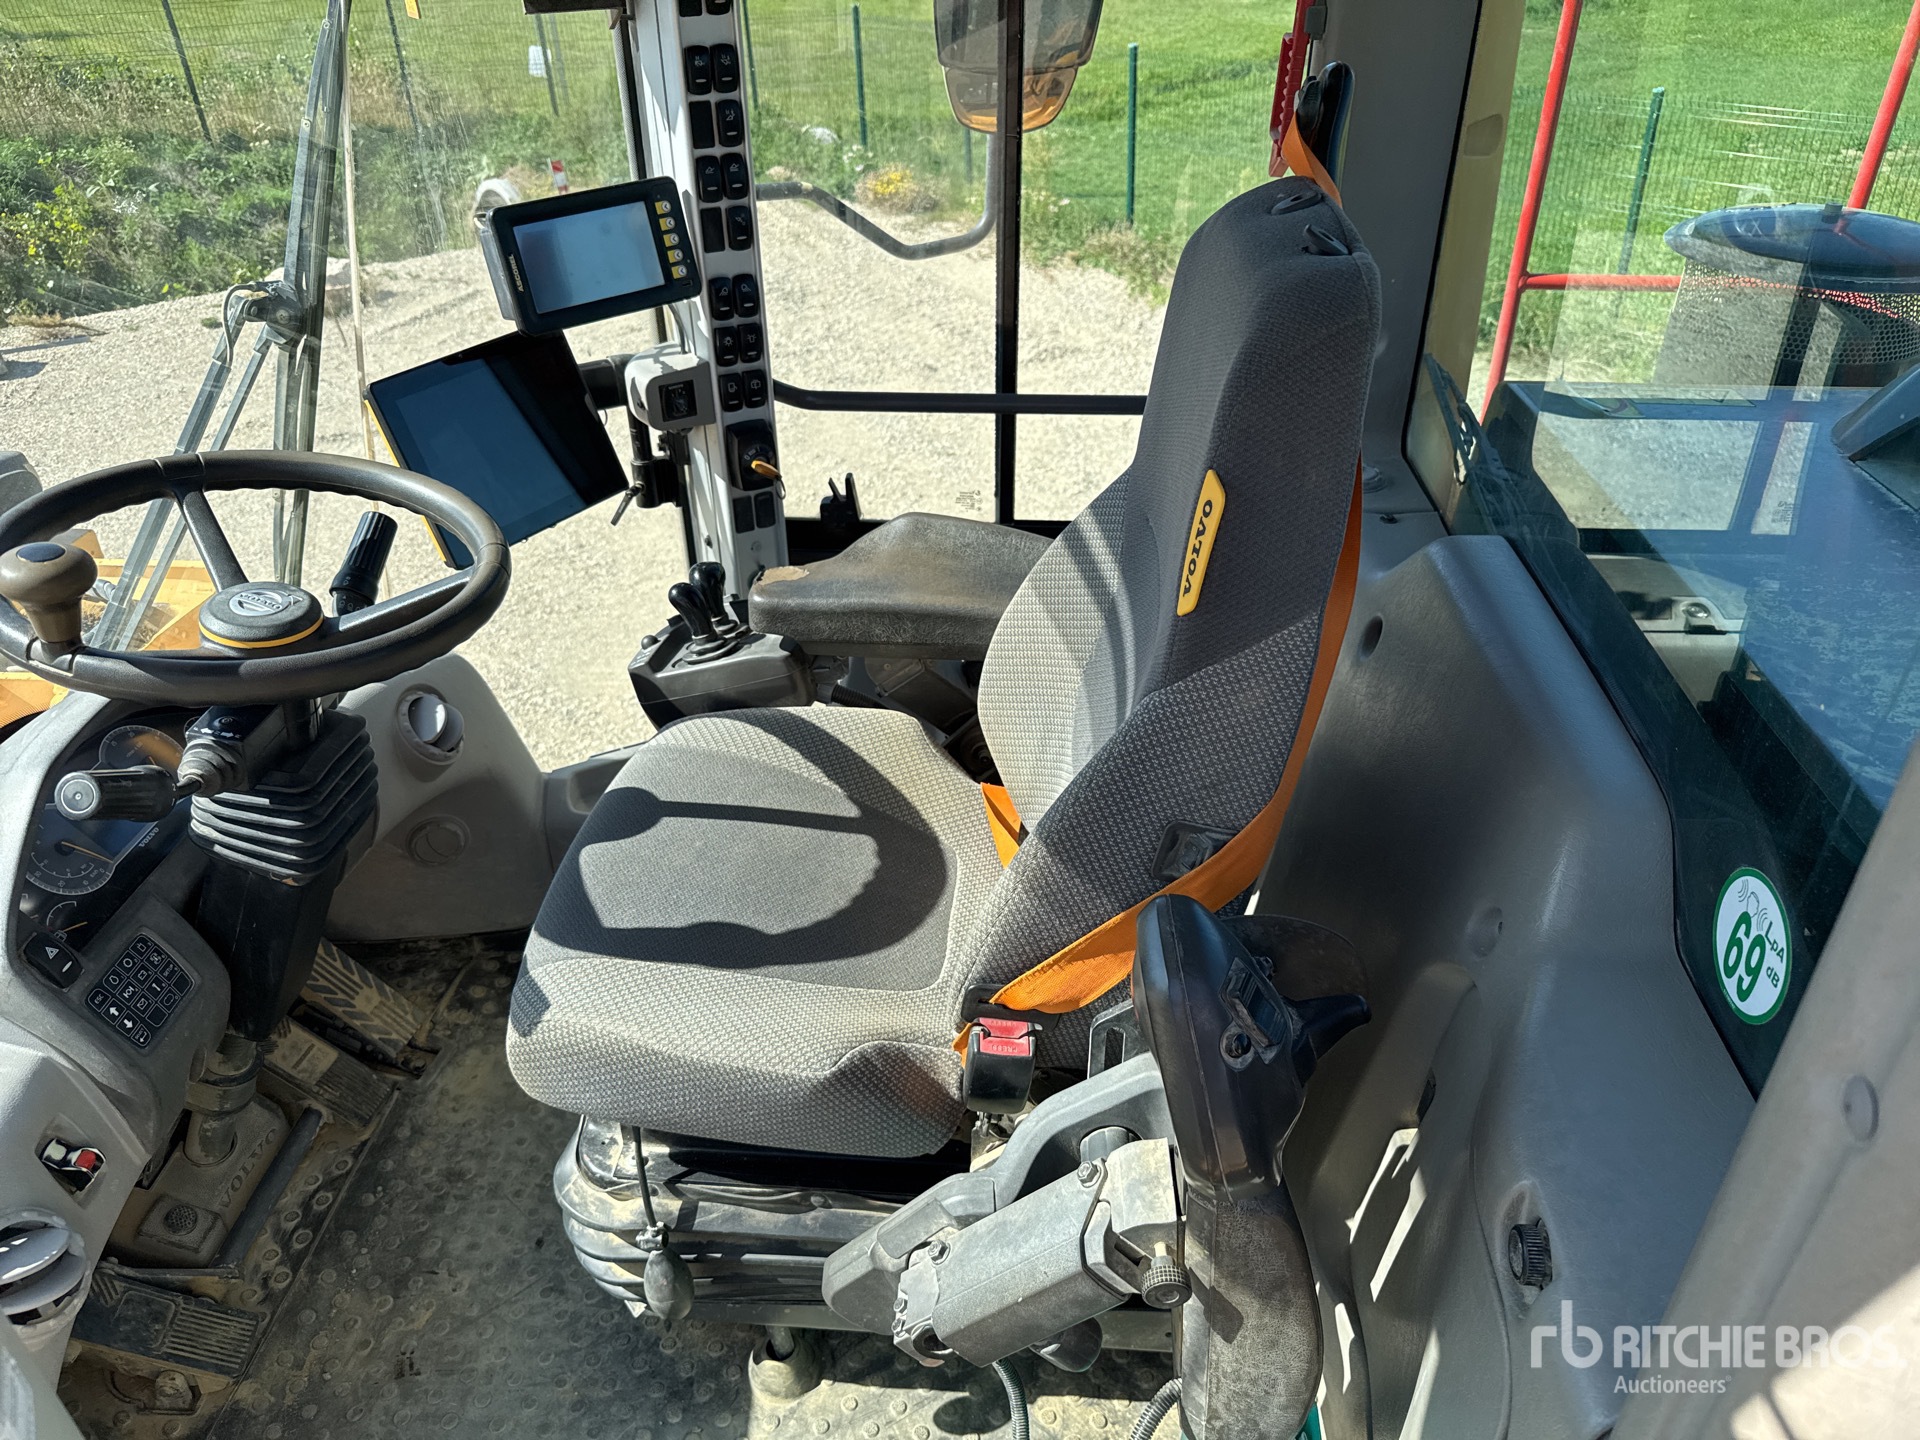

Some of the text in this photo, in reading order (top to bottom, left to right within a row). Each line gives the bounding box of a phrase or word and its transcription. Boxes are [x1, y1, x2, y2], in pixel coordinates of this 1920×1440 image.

[1183, 499, 1213, 597] VOLVO
[139, 827, 160, 848] VOLVO
[1723, 911, 1767, 1003] 69
[1764, 921, 1785, 963] LpA
[1766, 966, 1781, 989] dB
[94, 994, 104, 1004] ESC
[220, 1128, 277, 1208] VOLVO
